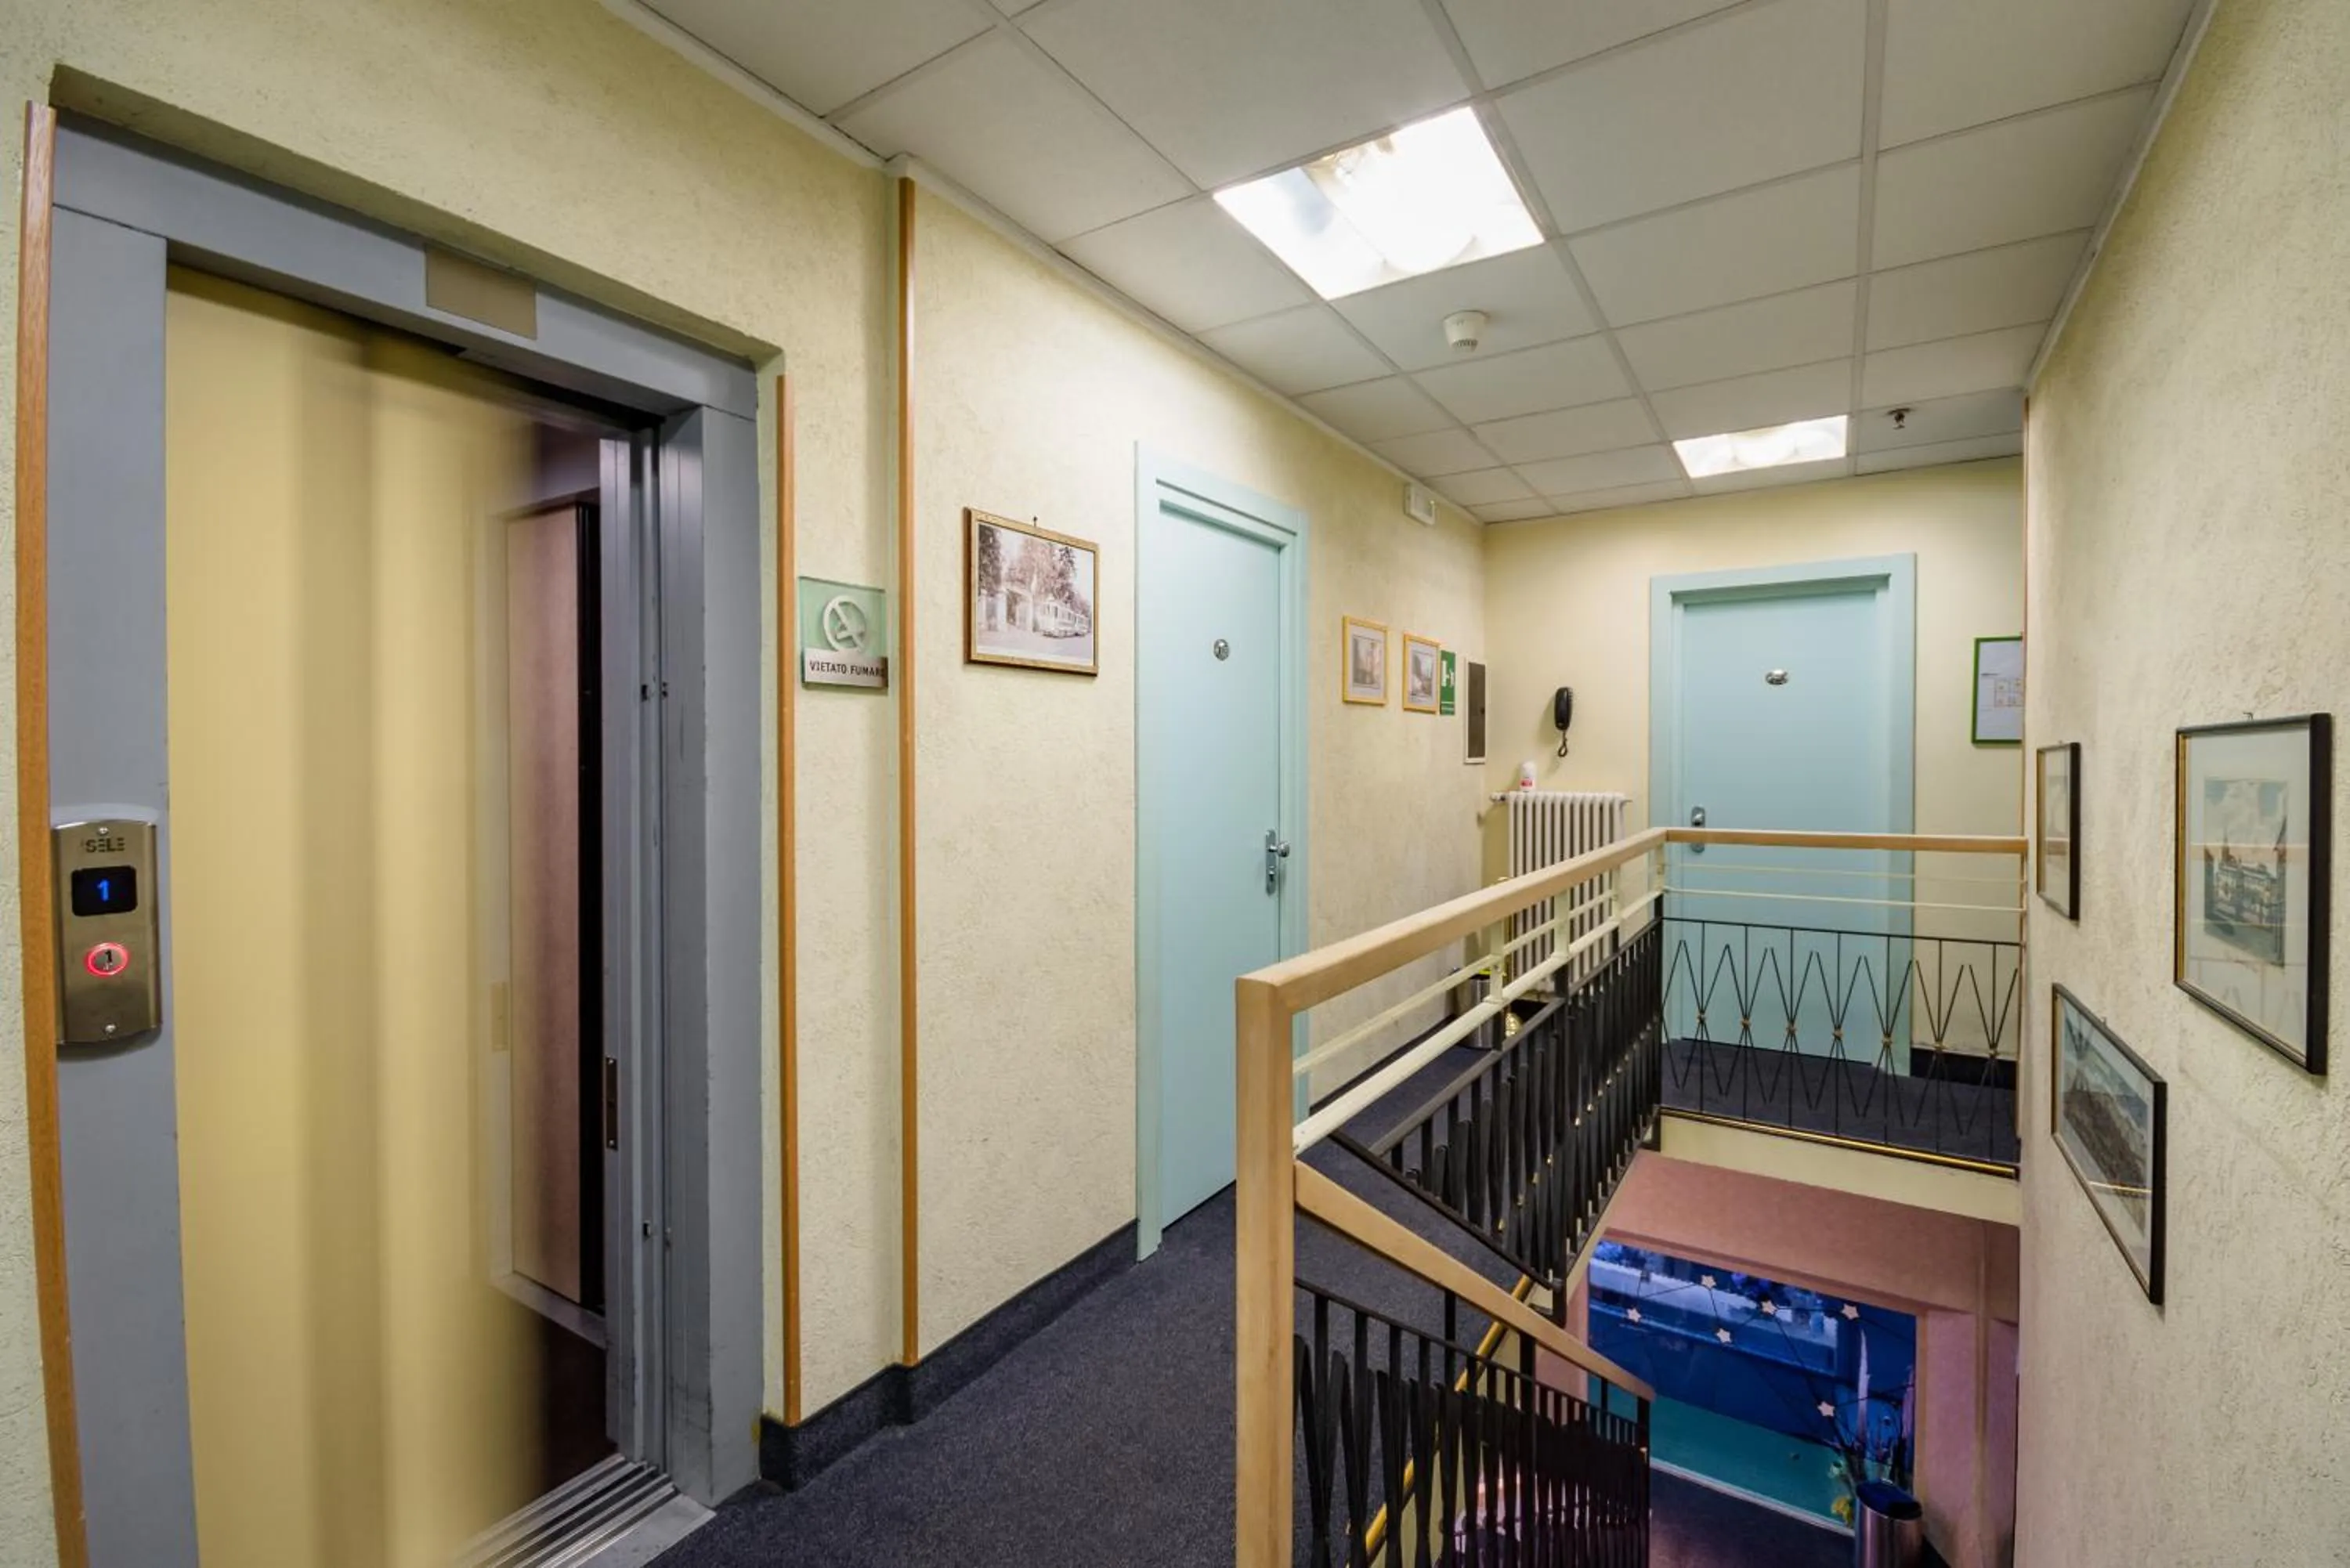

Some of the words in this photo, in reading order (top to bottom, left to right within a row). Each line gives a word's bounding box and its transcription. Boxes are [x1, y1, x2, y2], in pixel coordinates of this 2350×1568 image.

[810, 660, 847, 674] VIETATO
[85, 837, 125, 853] SELE
[97, 880, 109, 901] 1
[105, 949, 112, 963] 1
